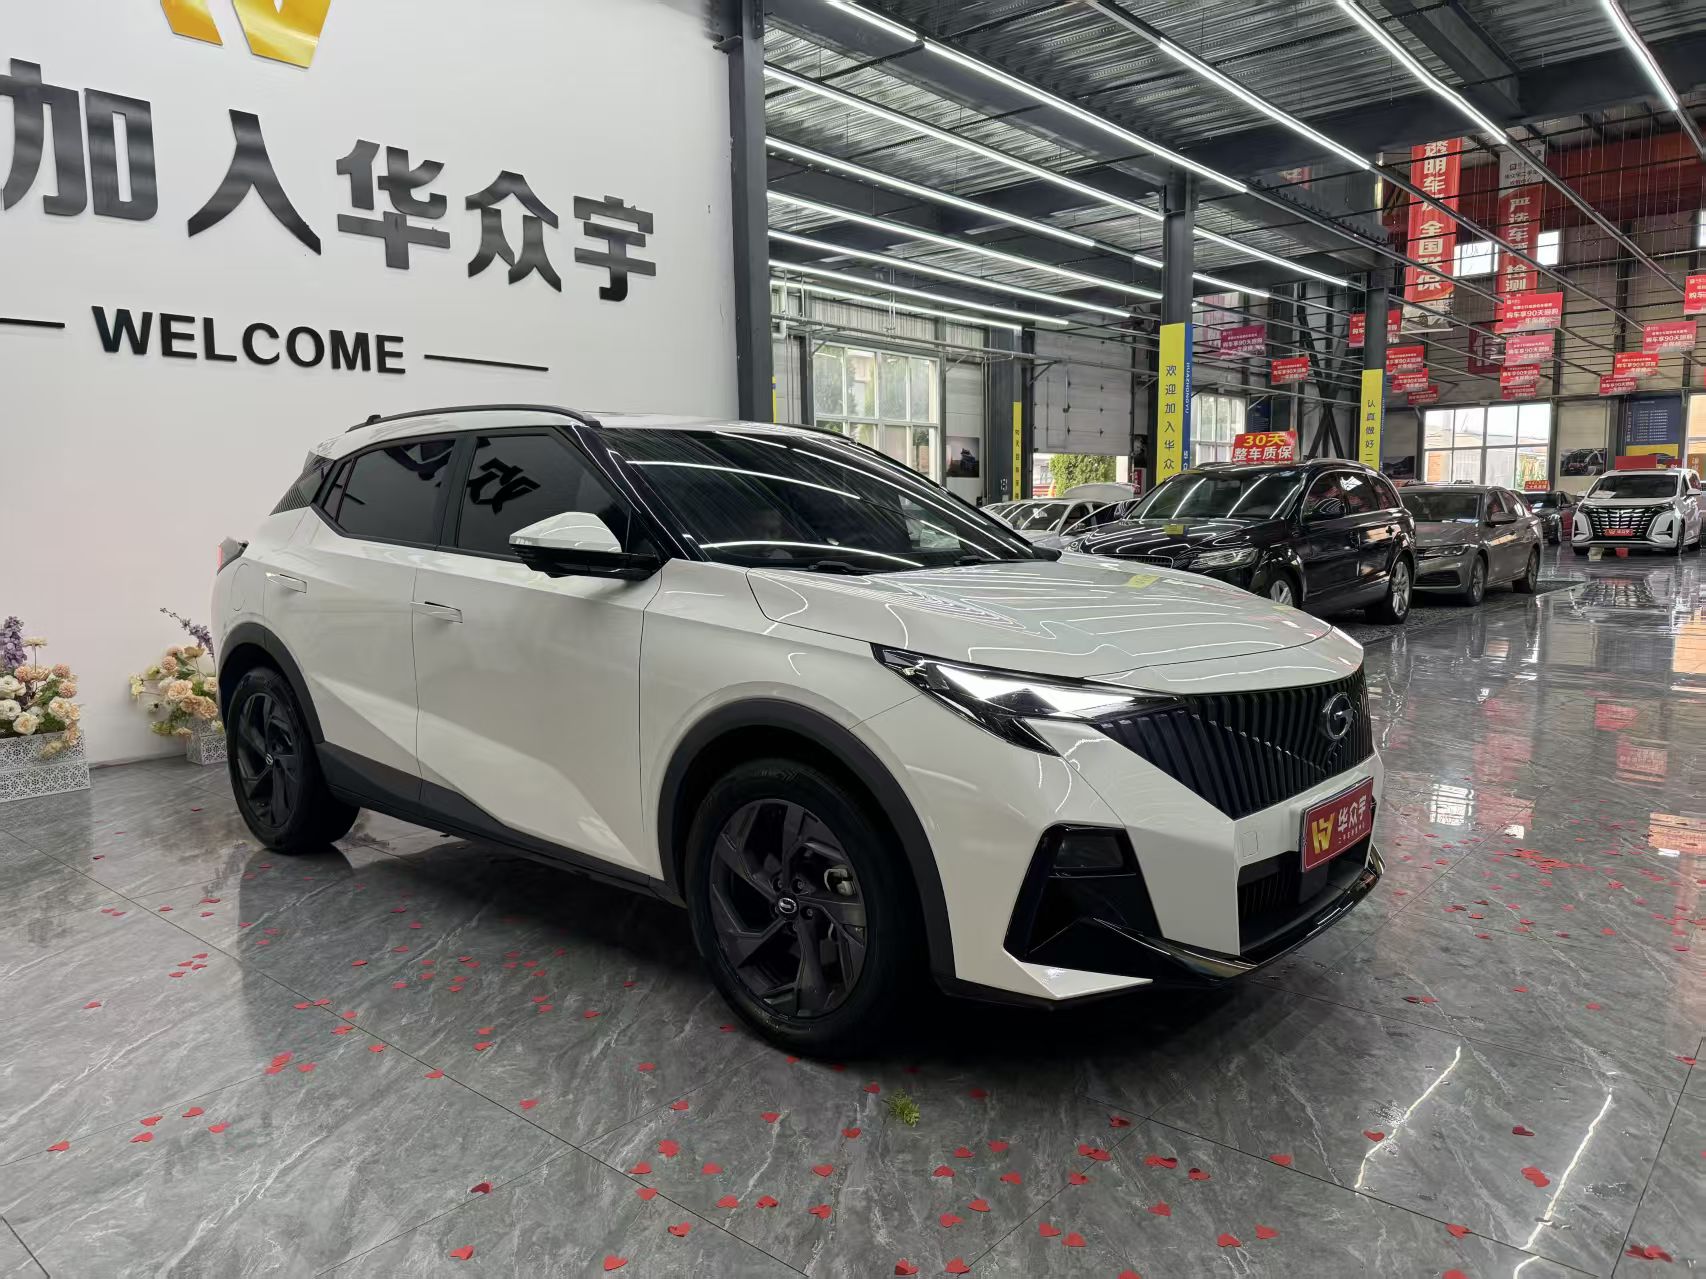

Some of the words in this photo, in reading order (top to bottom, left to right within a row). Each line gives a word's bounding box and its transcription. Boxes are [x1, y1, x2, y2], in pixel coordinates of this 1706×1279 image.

[0, 57, 656, 302] 加入华众宇
[91, 305, 406, 374] WELCOME
[1163, 365, 1177, 481] 欢迎加入华众
[1233, 445, 1292, 461] 整车质保
[1243, 432, 1287, 446] 30天
[1365, 400, 1376, 462] 认真做好二
[1338, 795, 1367, 832] 华众宇
